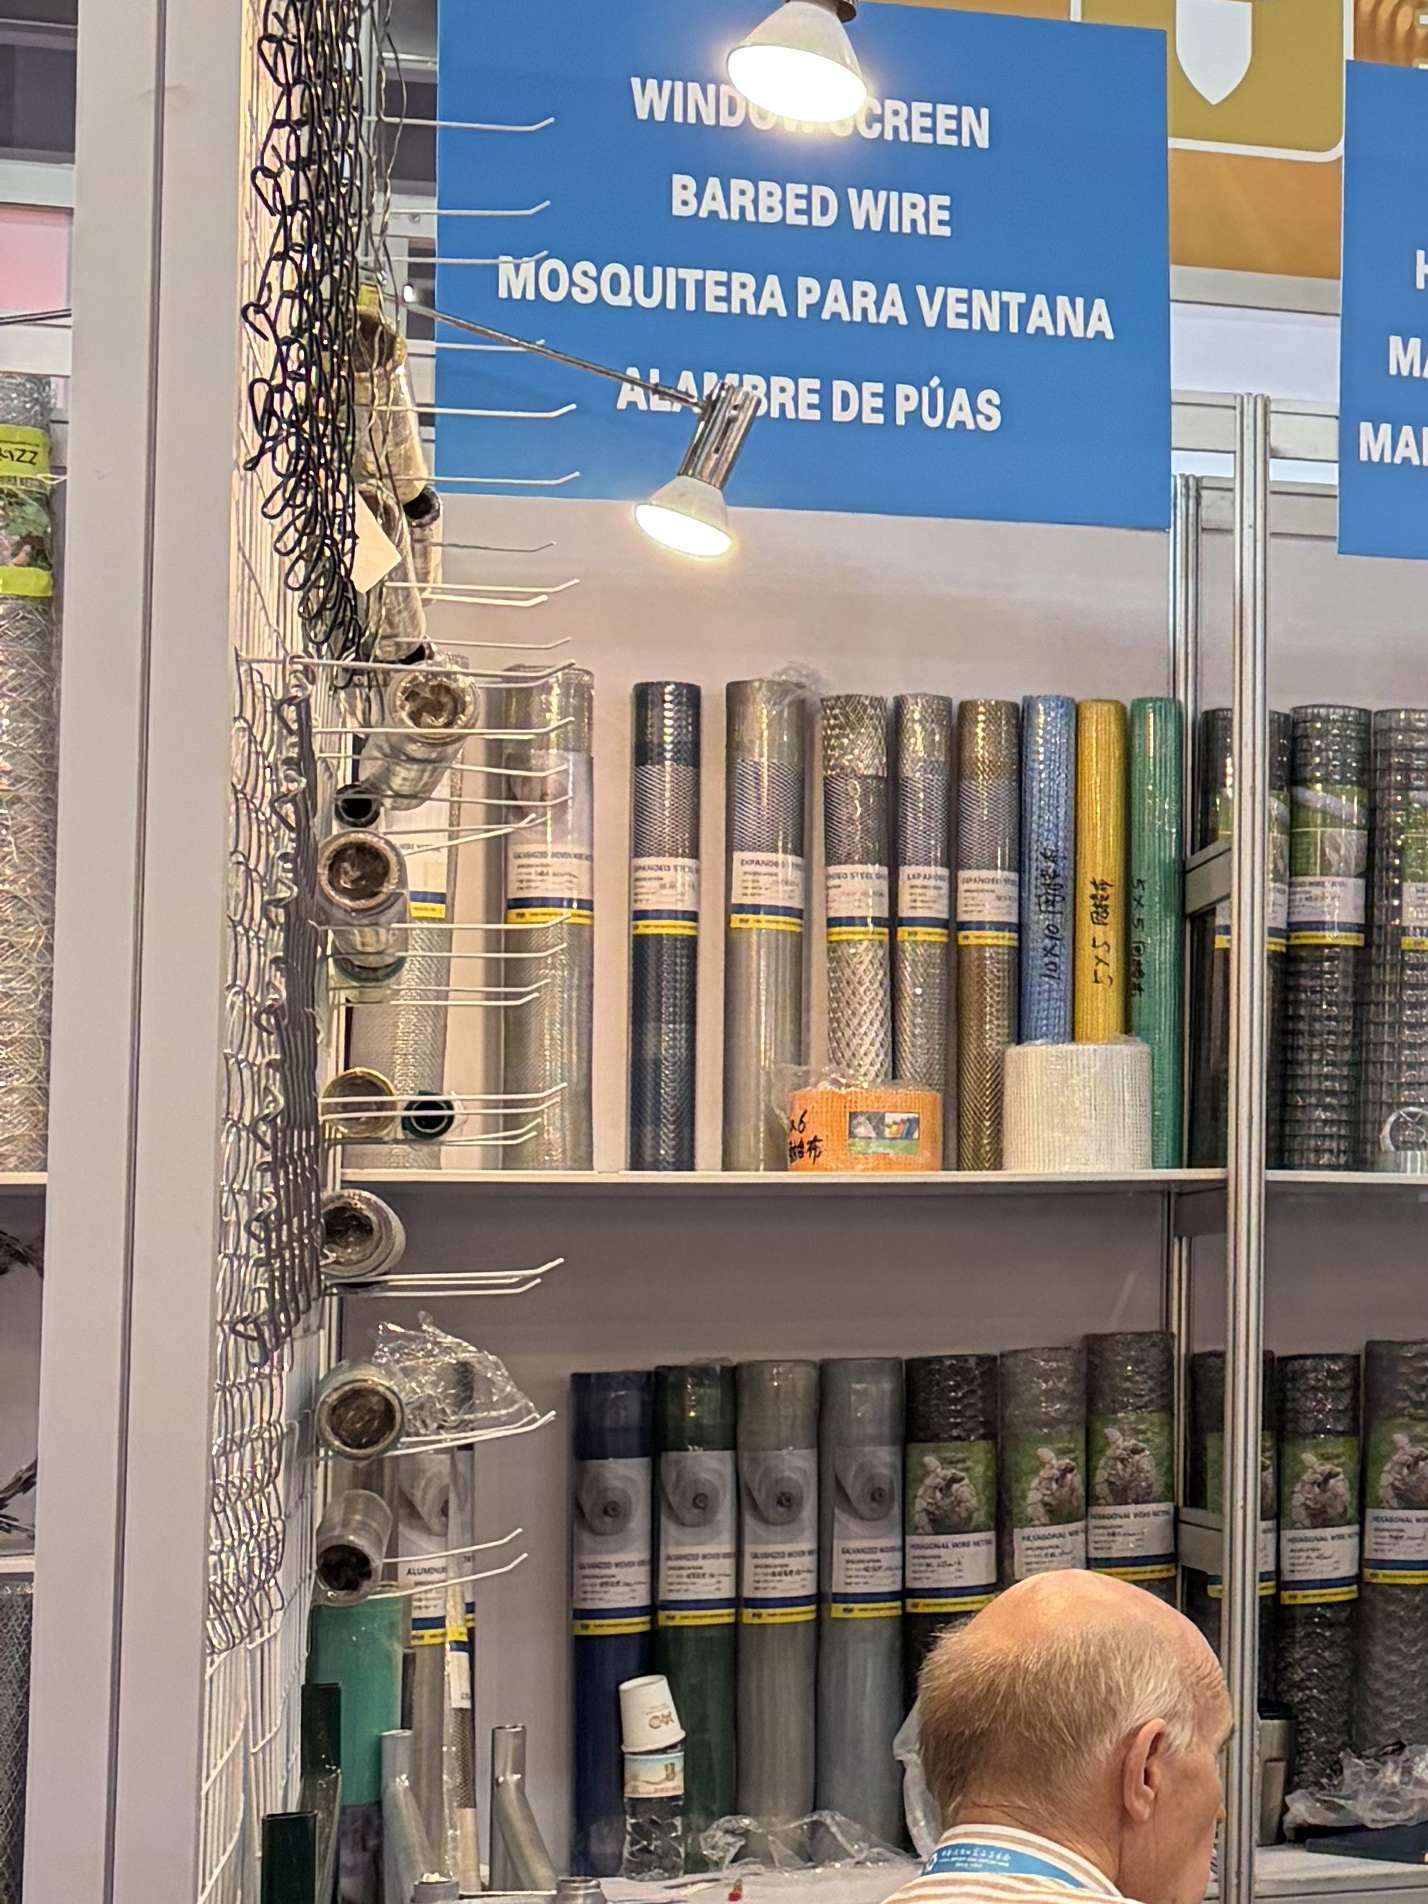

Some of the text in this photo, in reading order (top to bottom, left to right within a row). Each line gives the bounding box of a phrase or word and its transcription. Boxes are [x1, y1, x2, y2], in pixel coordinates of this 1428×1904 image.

[672, 174, 952, 238] BARBED WIRE
[497, 256, 1114, 340] MOSQUITERA PARA VENTANA
[831, 380, 885, 426] DE
[895, 374, 1002, 432] PÚAS
